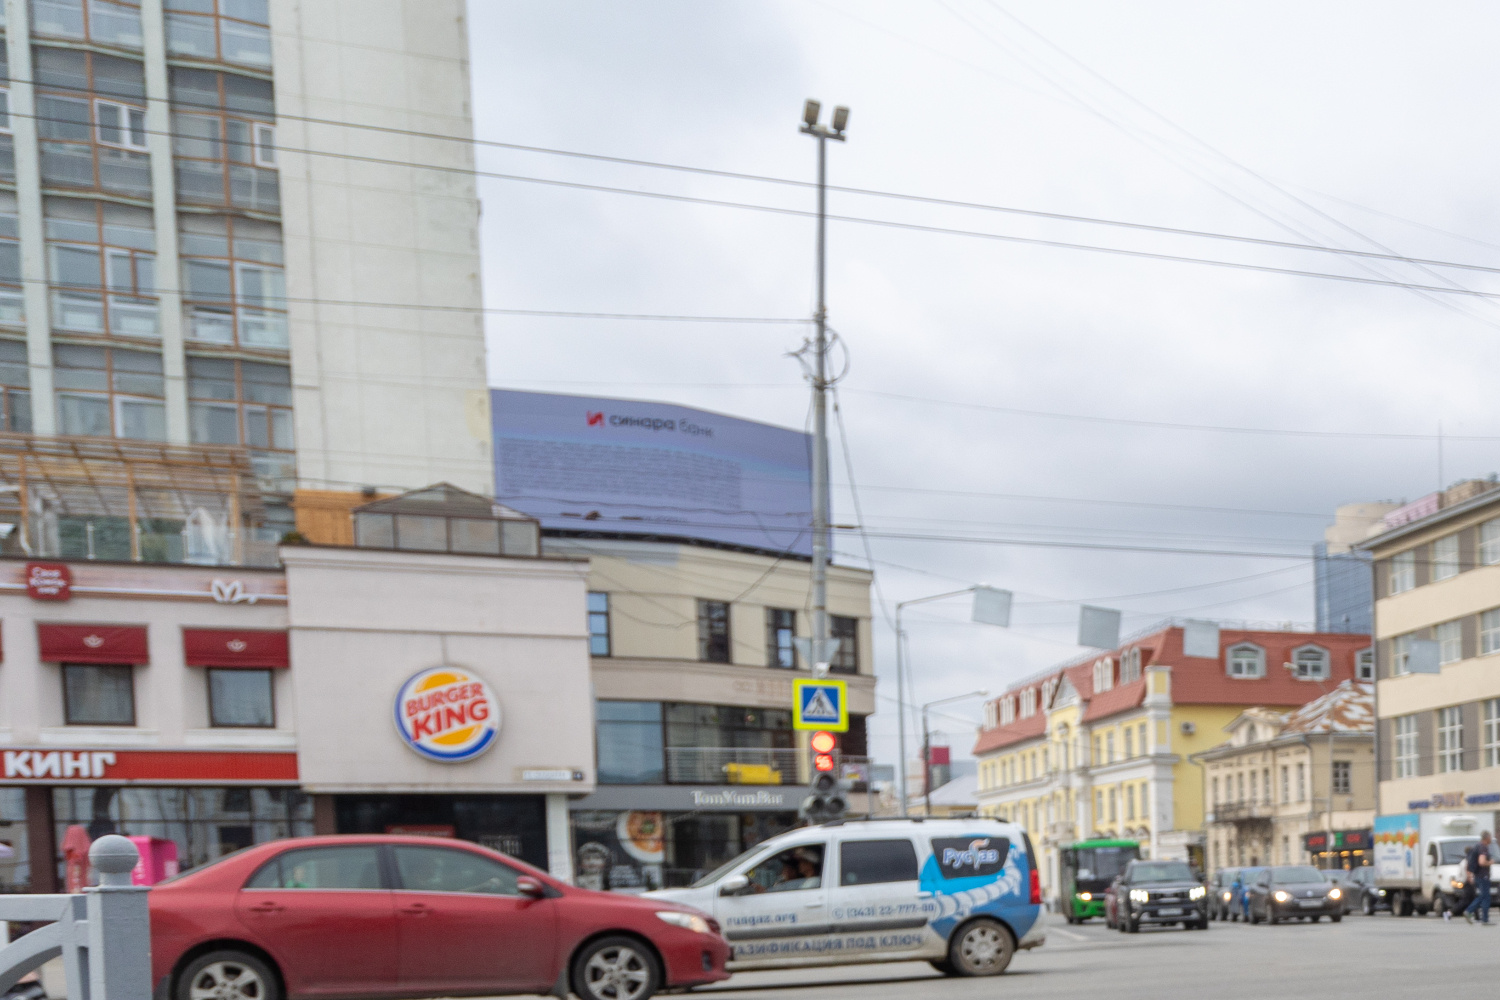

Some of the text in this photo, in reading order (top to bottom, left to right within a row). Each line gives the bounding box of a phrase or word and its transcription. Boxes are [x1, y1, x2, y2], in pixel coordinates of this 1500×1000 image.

[405, 682, 484, 717] BURGER
[411, 699, 489, 742] KING
[4, 751, 117, 778] КИНГ
[733, 931, 924, 957] АЗИФИКАЦИЯ ПОД КЛЮЧ
